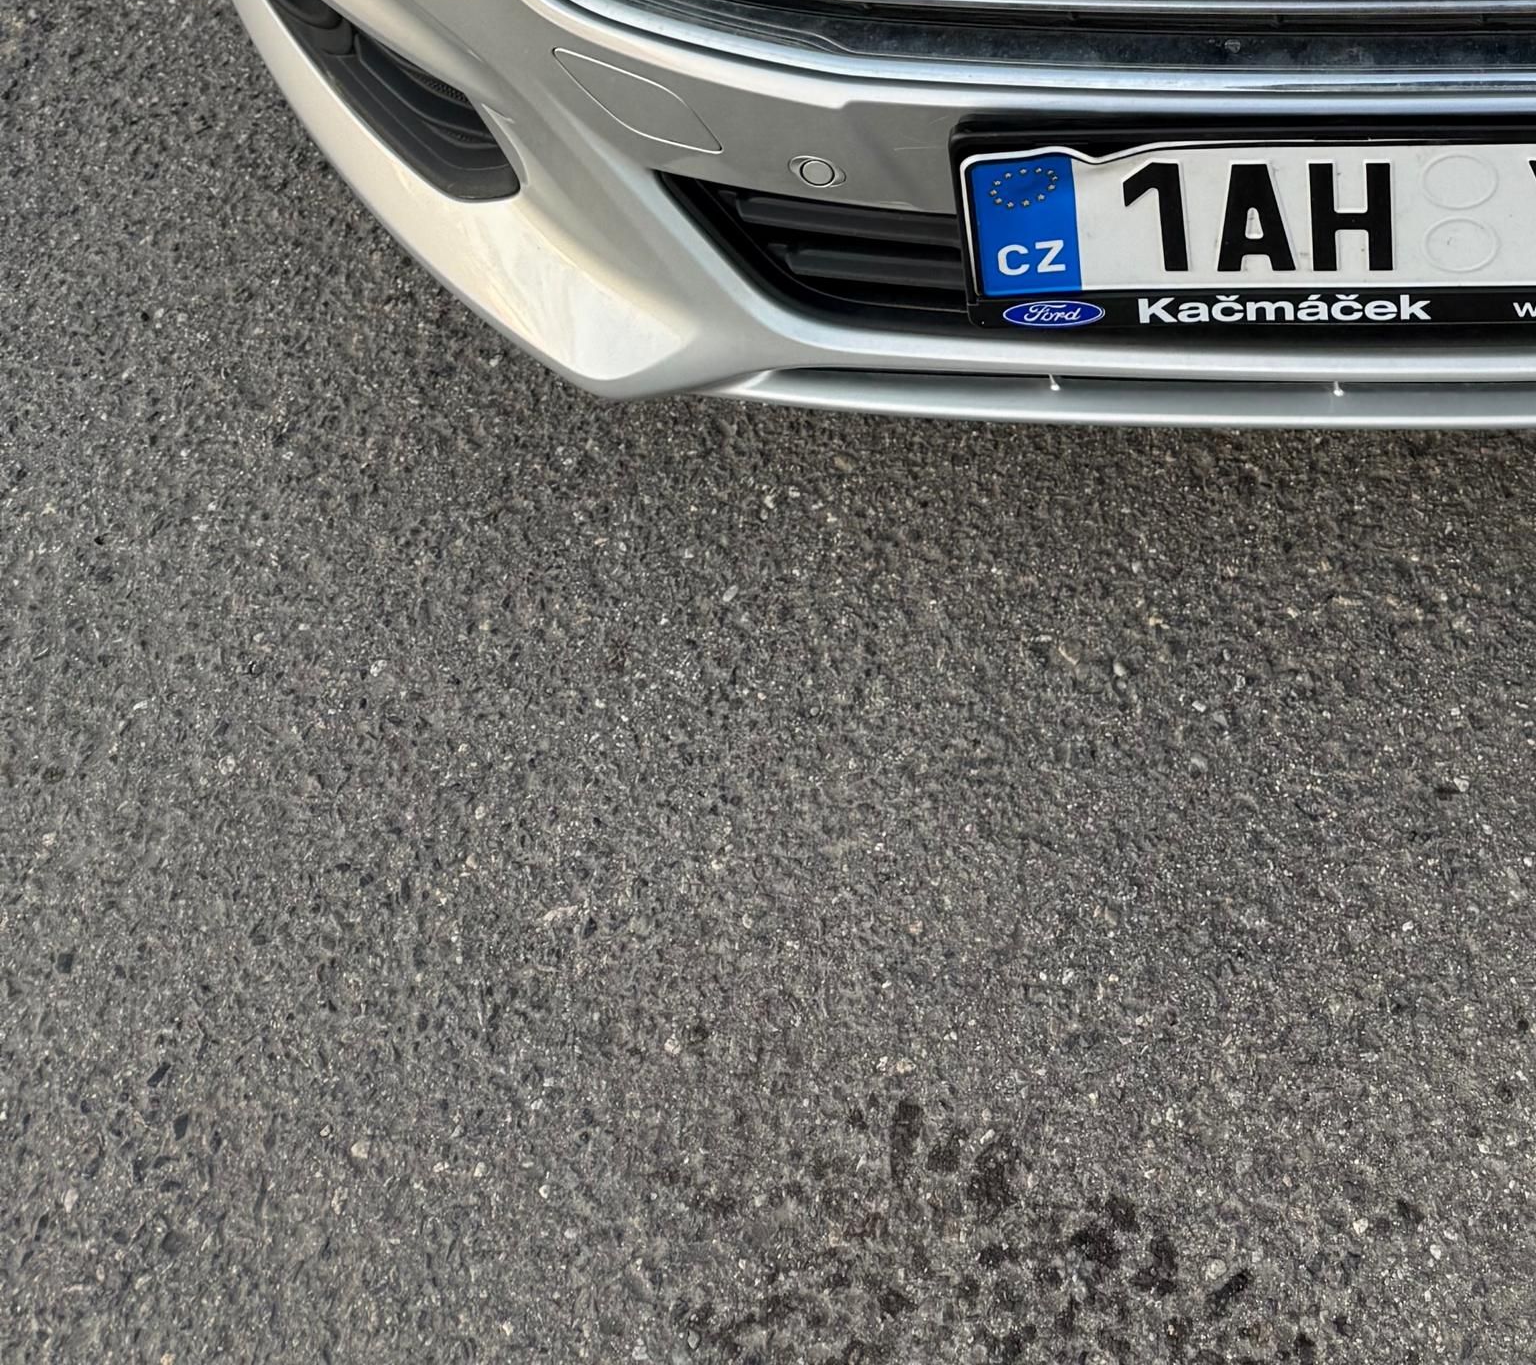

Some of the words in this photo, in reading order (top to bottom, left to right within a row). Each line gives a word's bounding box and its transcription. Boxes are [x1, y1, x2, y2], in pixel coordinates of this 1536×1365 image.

[1122, 161, 1395, 272] 1AH
[997, 239, 1067, 276] CZ
[1023, 303, 1082, 322] Ford
[1137, 294, 1432, 324] Kačmáček
